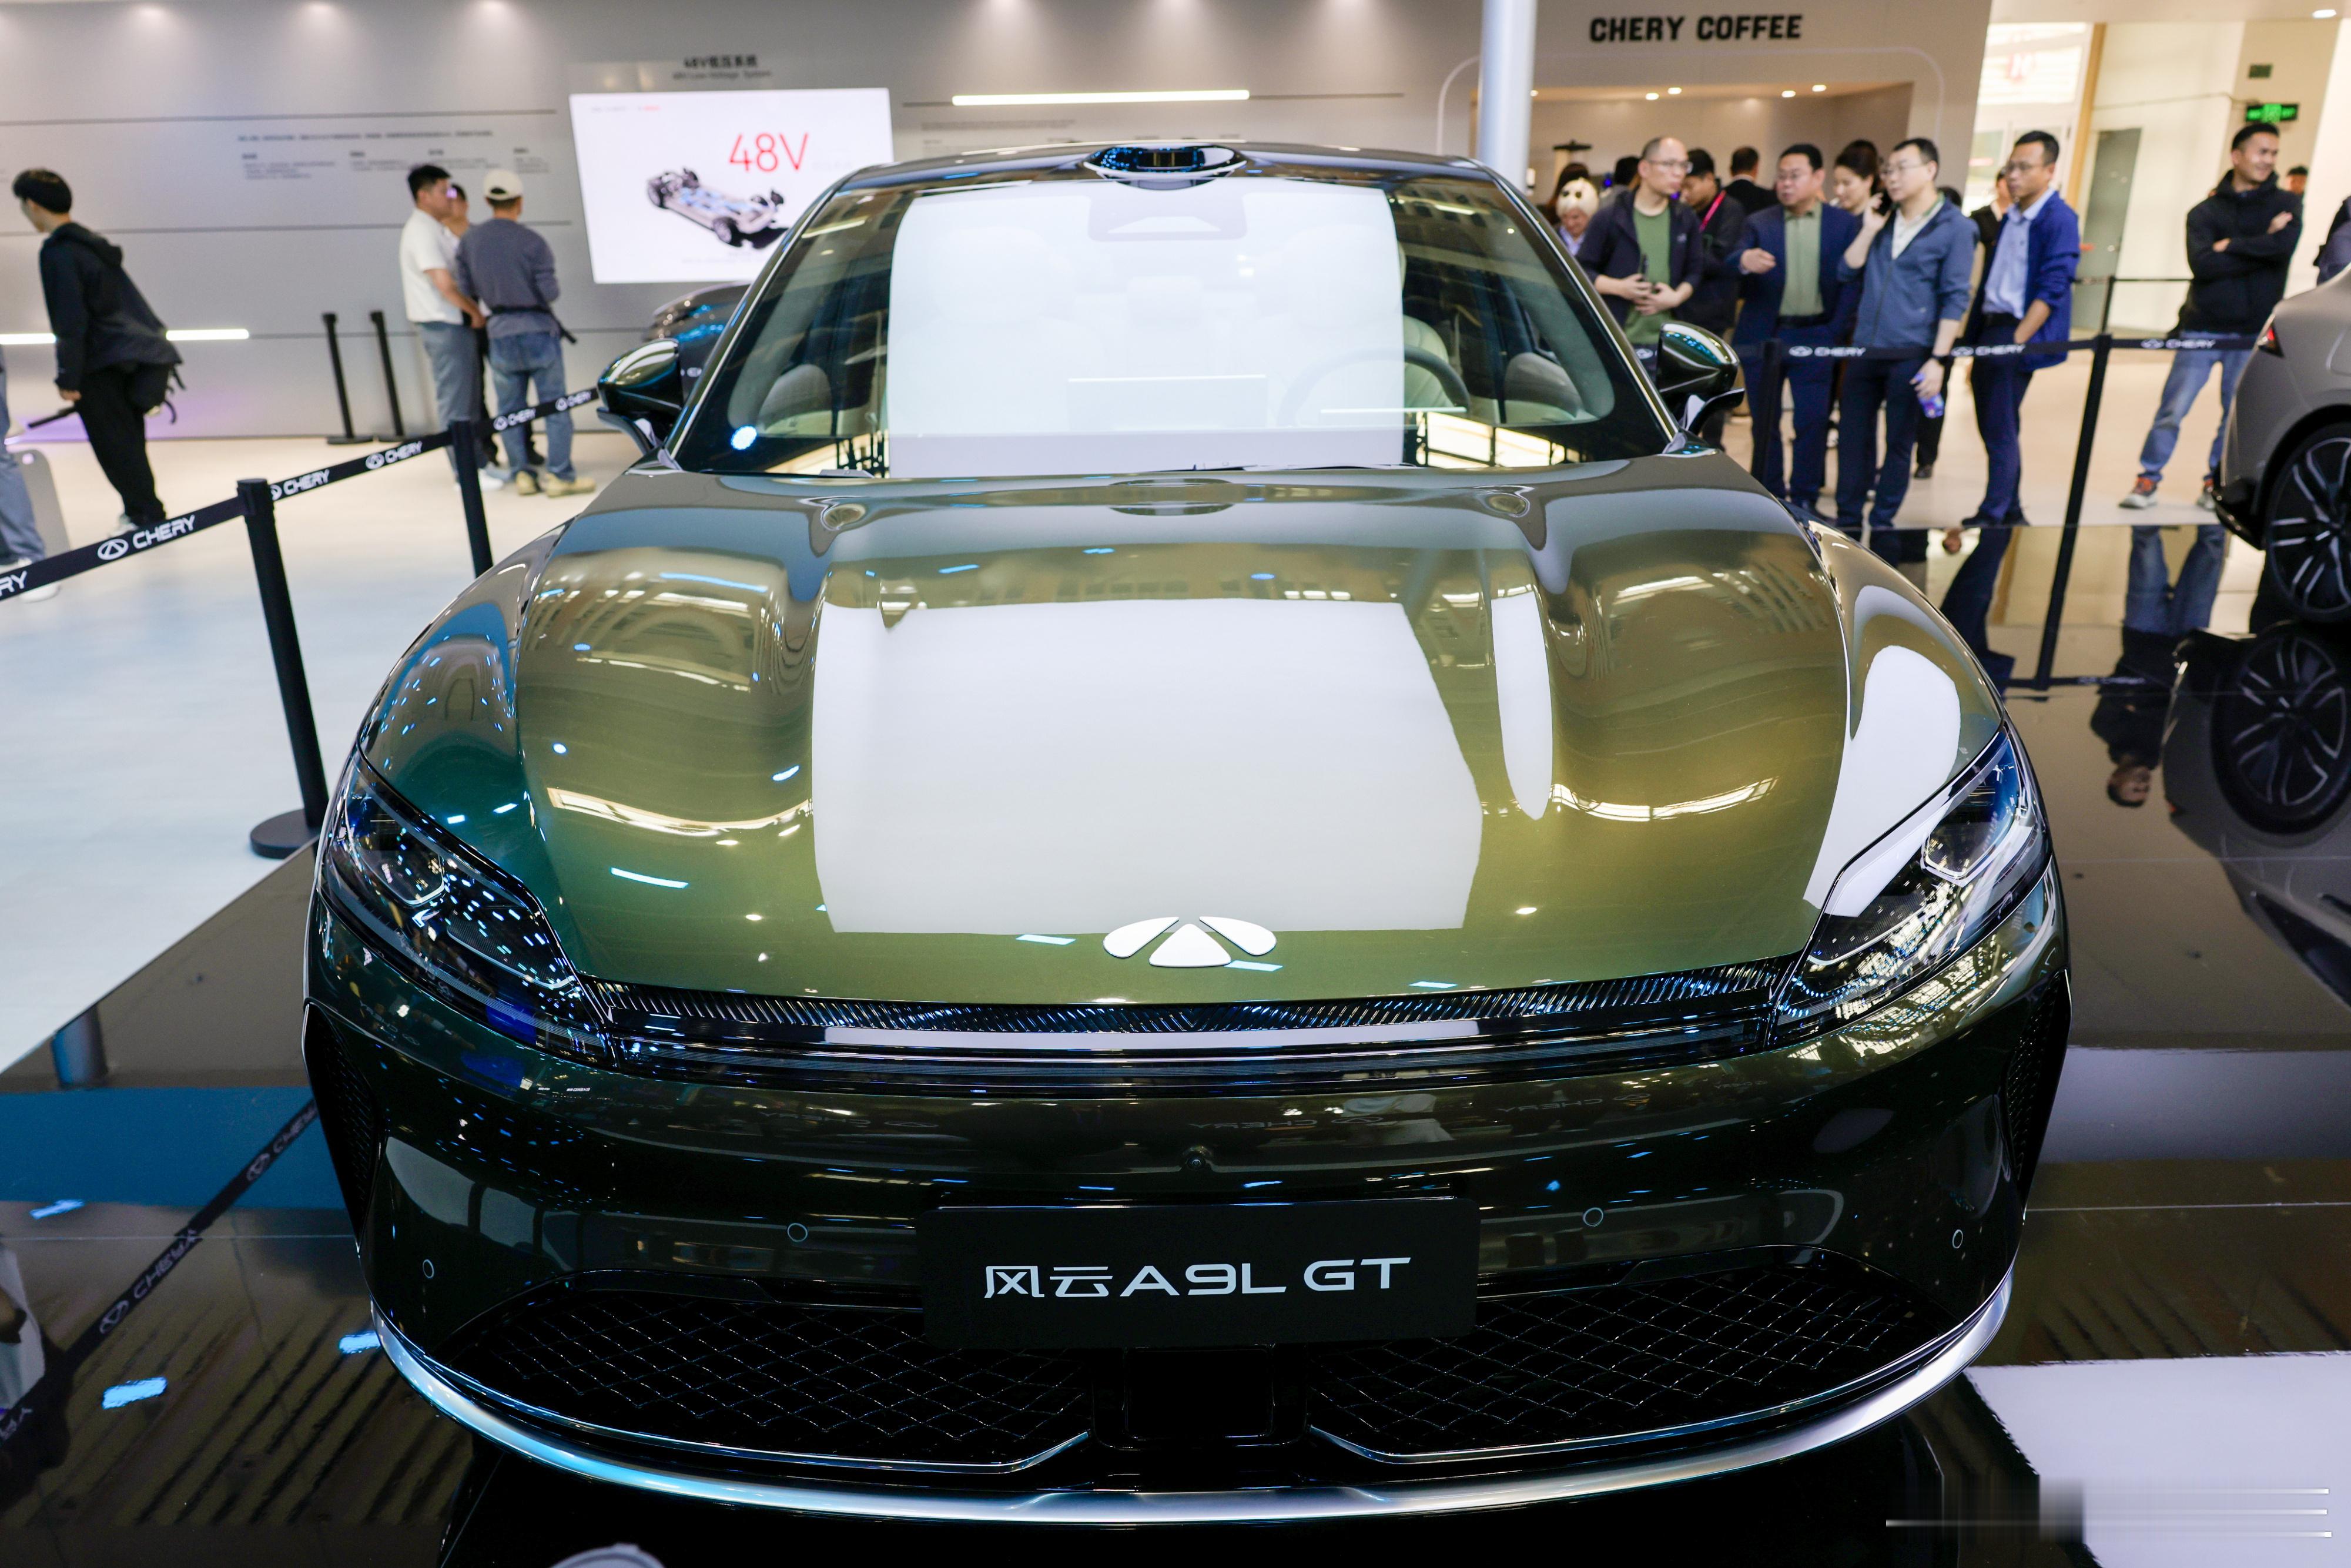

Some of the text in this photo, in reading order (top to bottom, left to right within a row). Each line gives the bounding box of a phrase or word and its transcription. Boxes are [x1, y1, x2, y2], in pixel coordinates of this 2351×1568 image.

[1590, 14, 1803, 42] CHERY COFFEE
[729, 133, 808, 172] 48V
[385, 441, 423, 464] CHERY
[283, 469, 330, 495] CHERY
[133, 514, 196, 549] CHERY
[984, 1257, 1411, 1298] 风云A9L GT
